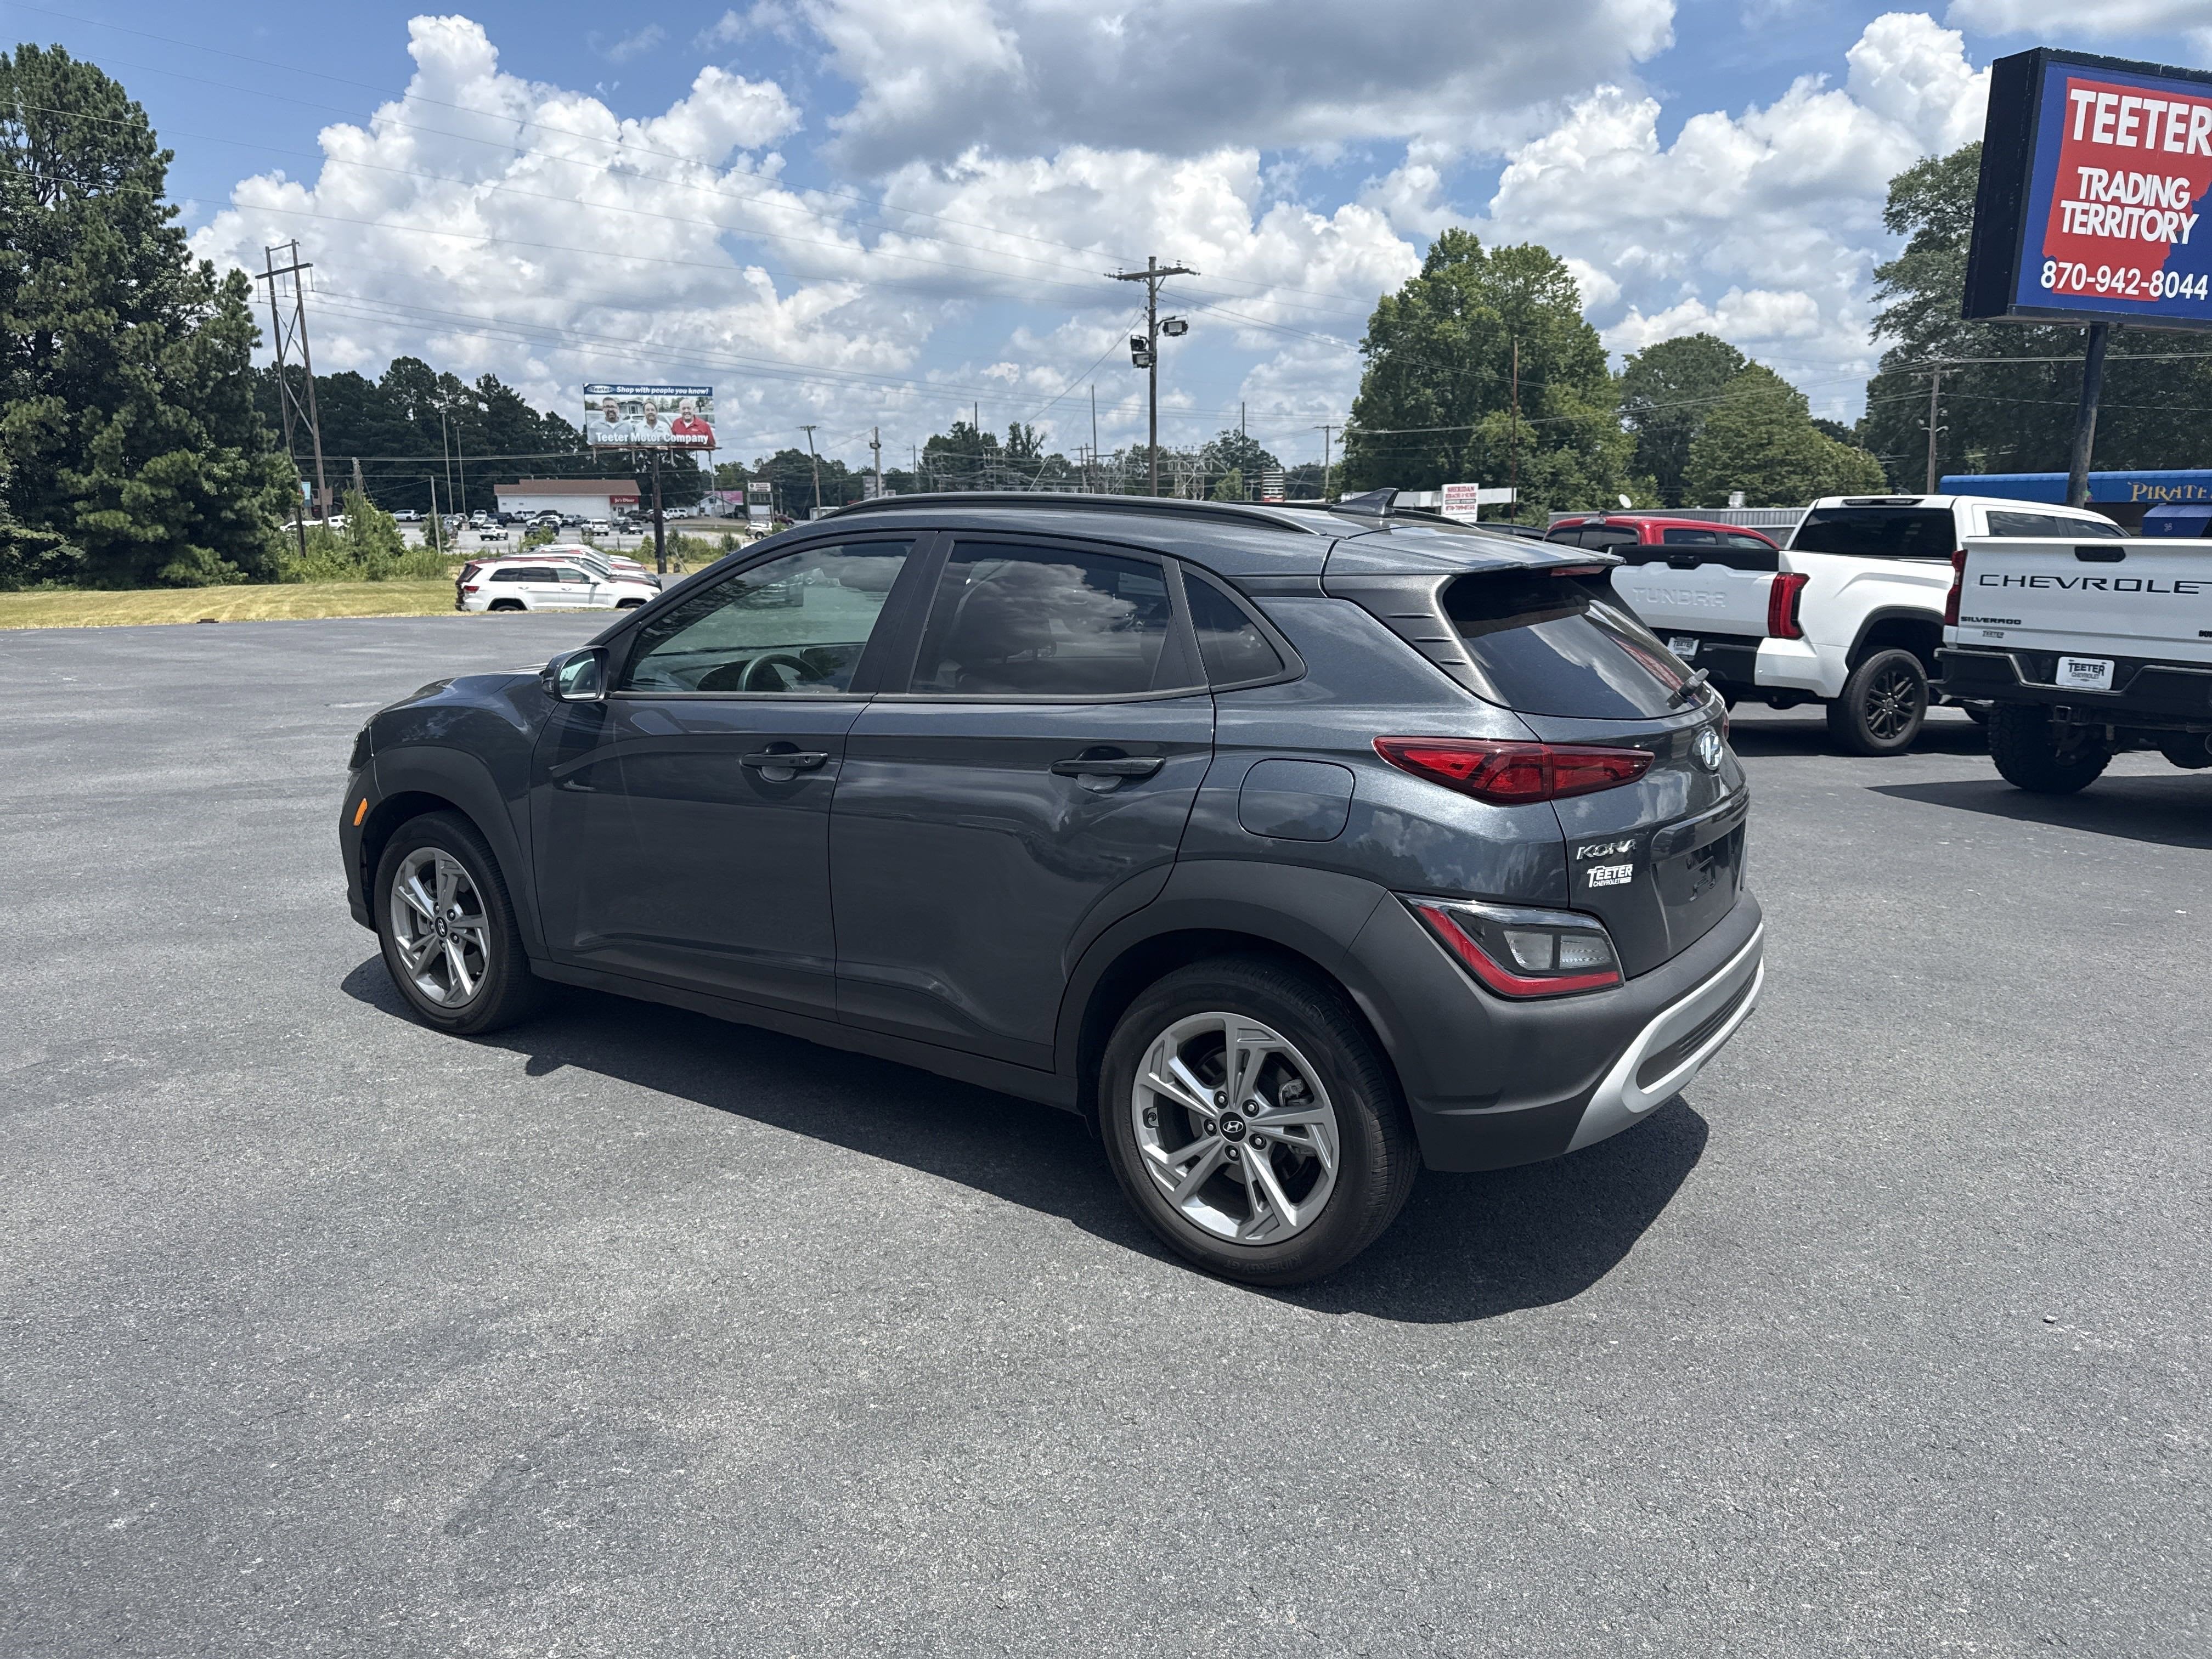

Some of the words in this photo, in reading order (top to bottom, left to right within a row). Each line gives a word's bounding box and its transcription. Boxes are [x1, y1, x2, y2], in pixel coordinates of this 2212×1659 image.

[2070, 88, 2212, 156] TEETER
[2077, 166, 2191, 210] TRADING
[2060, 200, 2200, 245] TERRITORY
[2040, 260, 2208, 301] 870-942-8044
[596, 432, 629, 442] Teeter
[631, 433, 661, 443] Motor
[663, 434, 709, 444] Company
[2127, 481, 2212, 502] PIRATE
[1979, 574, 2212, 594] CHEVROLE
[1632, 587, 1726, 607] TUNDRA
[1961, 616, 2022, 625] SILVERADO
[2068, 663, 2105, 676] TEETER
[1576, 839, 1637, 860] KONA
[1587, 865, 1633, 888] TEETER
[1593, 878, 1621, 887] CHEVROLET
